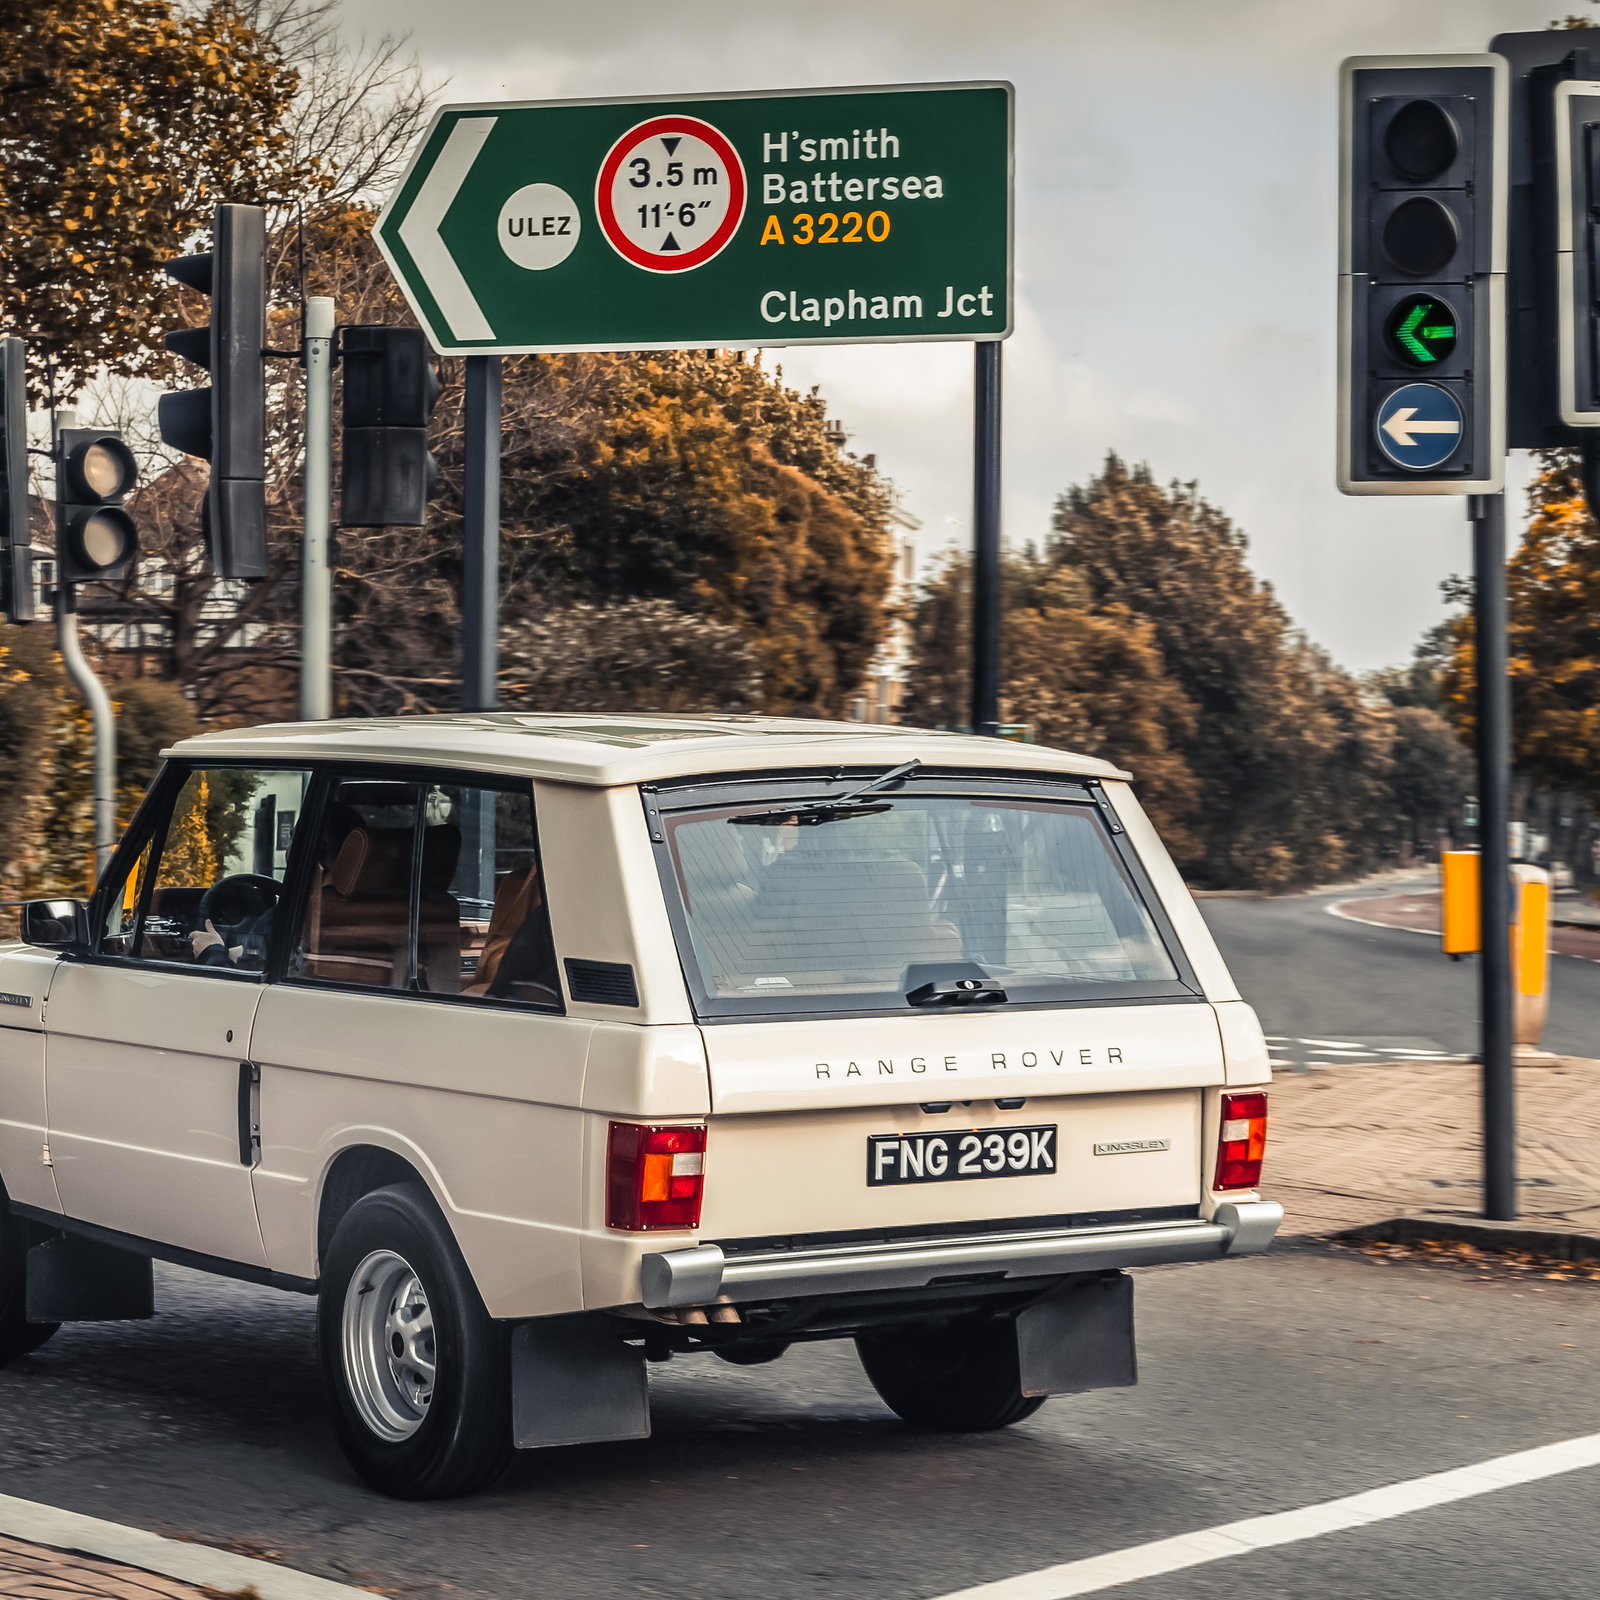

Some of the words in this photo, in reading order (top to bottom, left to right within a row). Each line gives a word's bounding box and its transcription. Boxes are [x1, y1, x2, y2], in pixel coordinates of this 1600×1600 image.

[628, 157, 684, 188] 3.5
[693, 167, 718, 185] m
[763, 172, 944, 205] Battersea
[508, 215, 572, 238] ULEZ
[760, 289, 923, 327] Clapham
[936, 285, 994, 318] Jct
[815, 1056, 958, 1079] RANGE
[991, 1047, 1123, 1070] ROVER
[875, 1138, 948, 1180] FNG
[958, 1130, 1053, 1174] 239K
[1097, 1140, 1166, 1153] KINGSLEY
